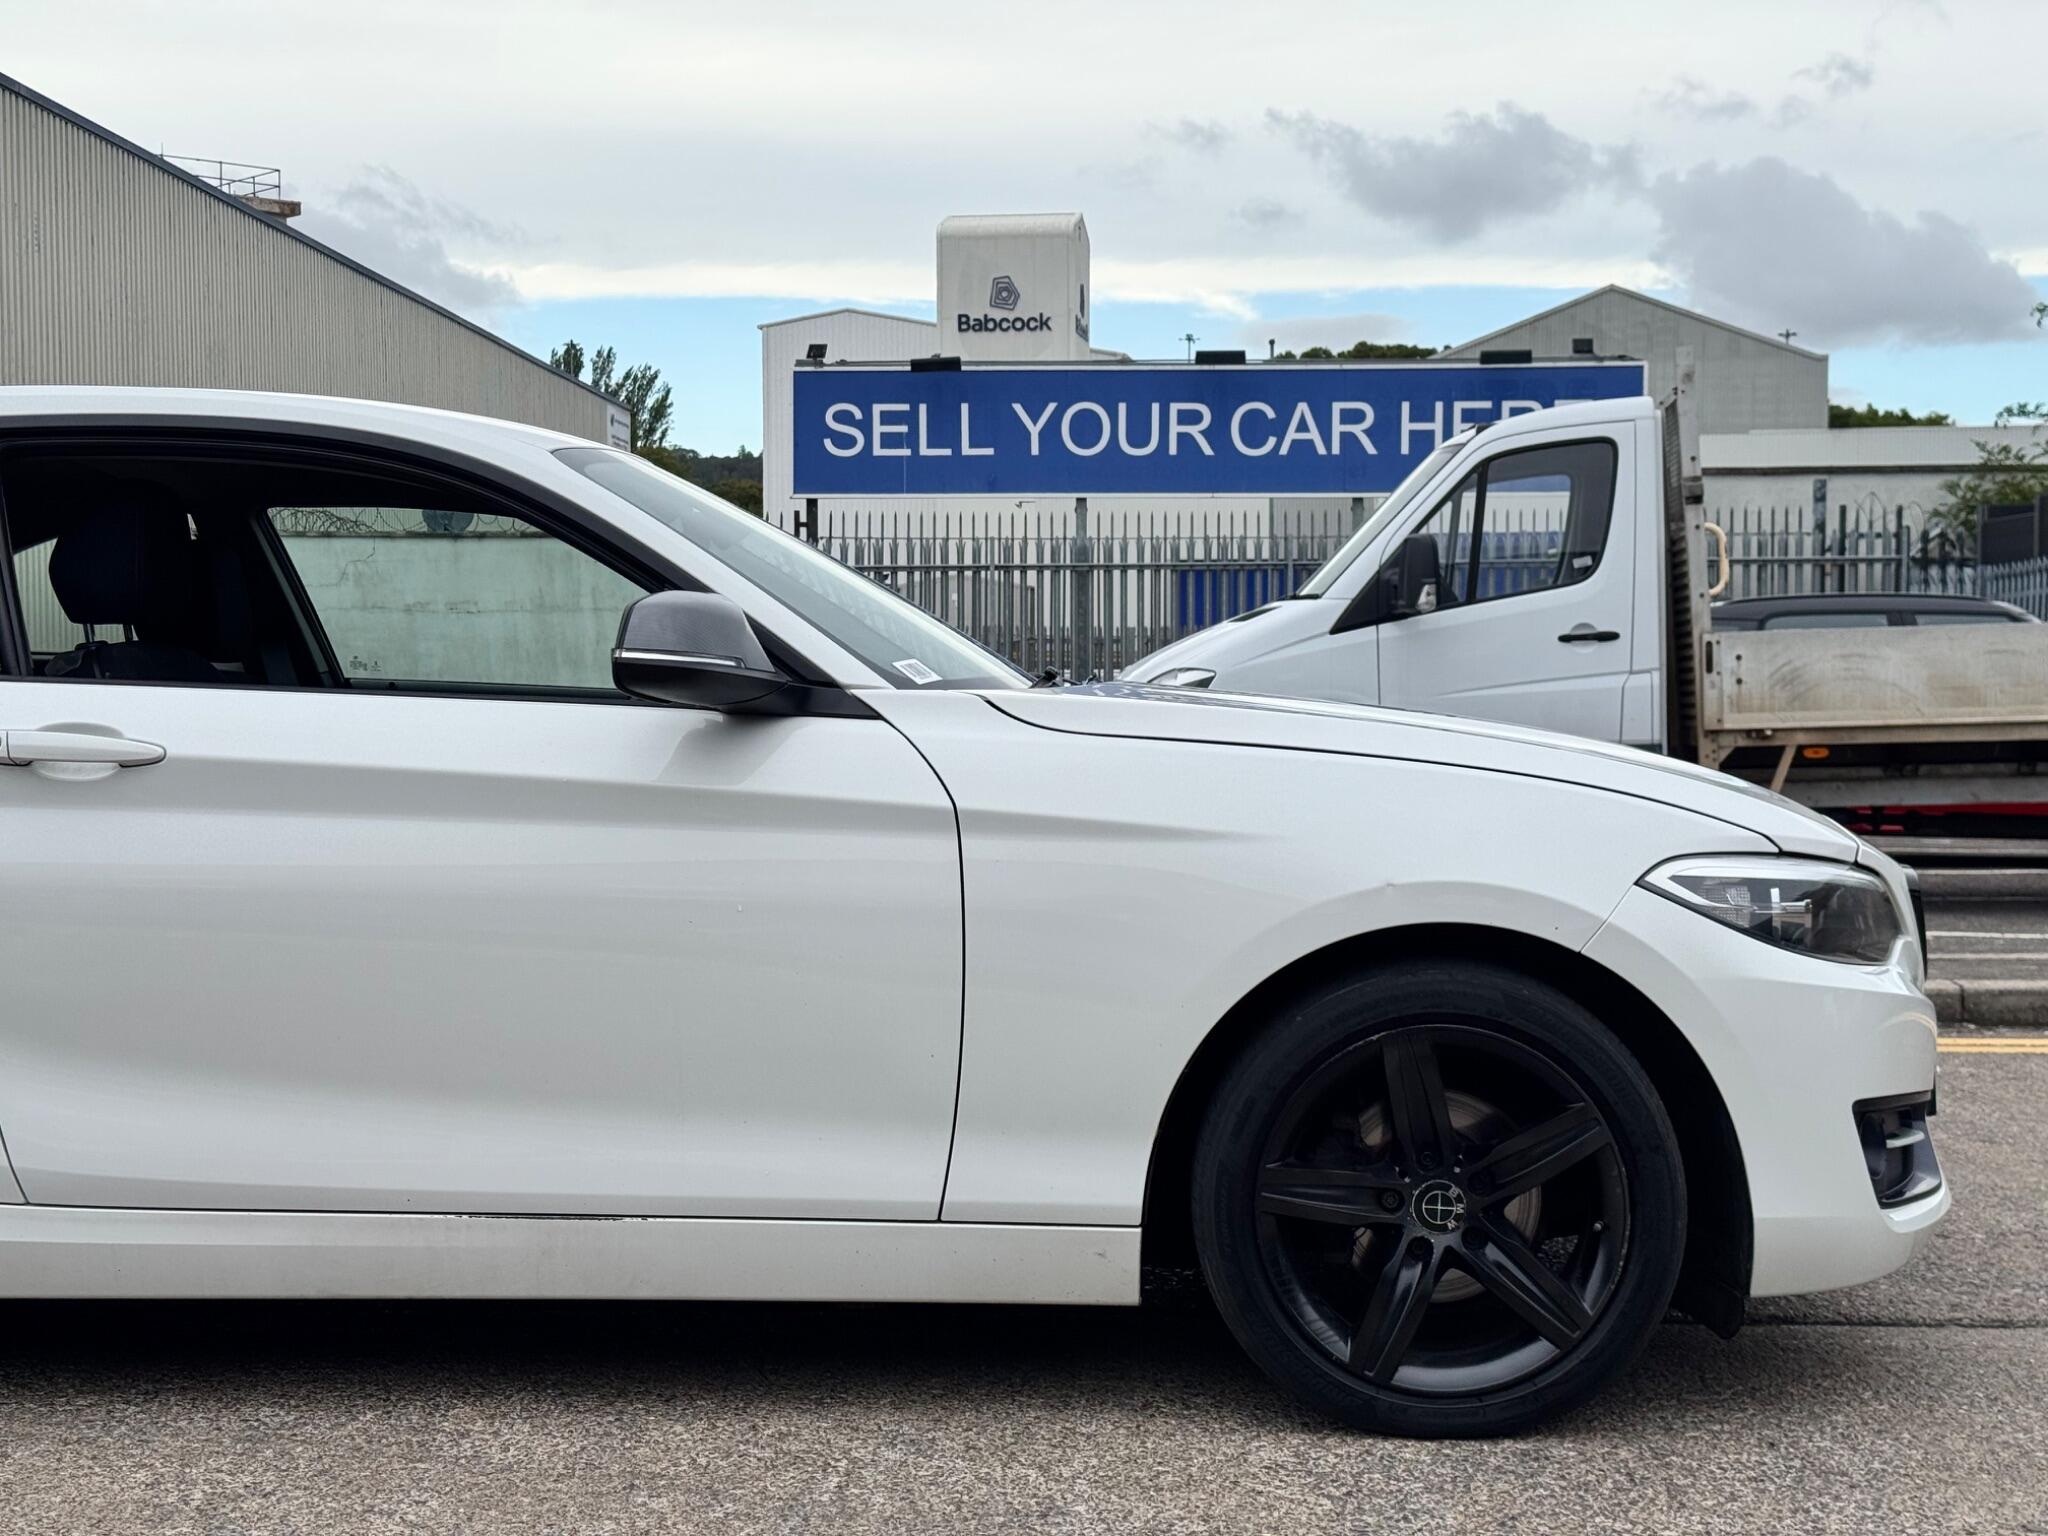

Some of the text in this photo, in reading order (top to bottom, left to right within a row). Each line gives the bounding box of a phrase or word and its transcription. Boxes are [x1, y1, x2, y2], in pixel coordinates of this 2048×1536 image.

[957, 313, 1052, 333] Babcock
[823, 399, 1593, 457] SELL YOUR CAR HE
[1446, 1186, 1465, 1230] BMW
